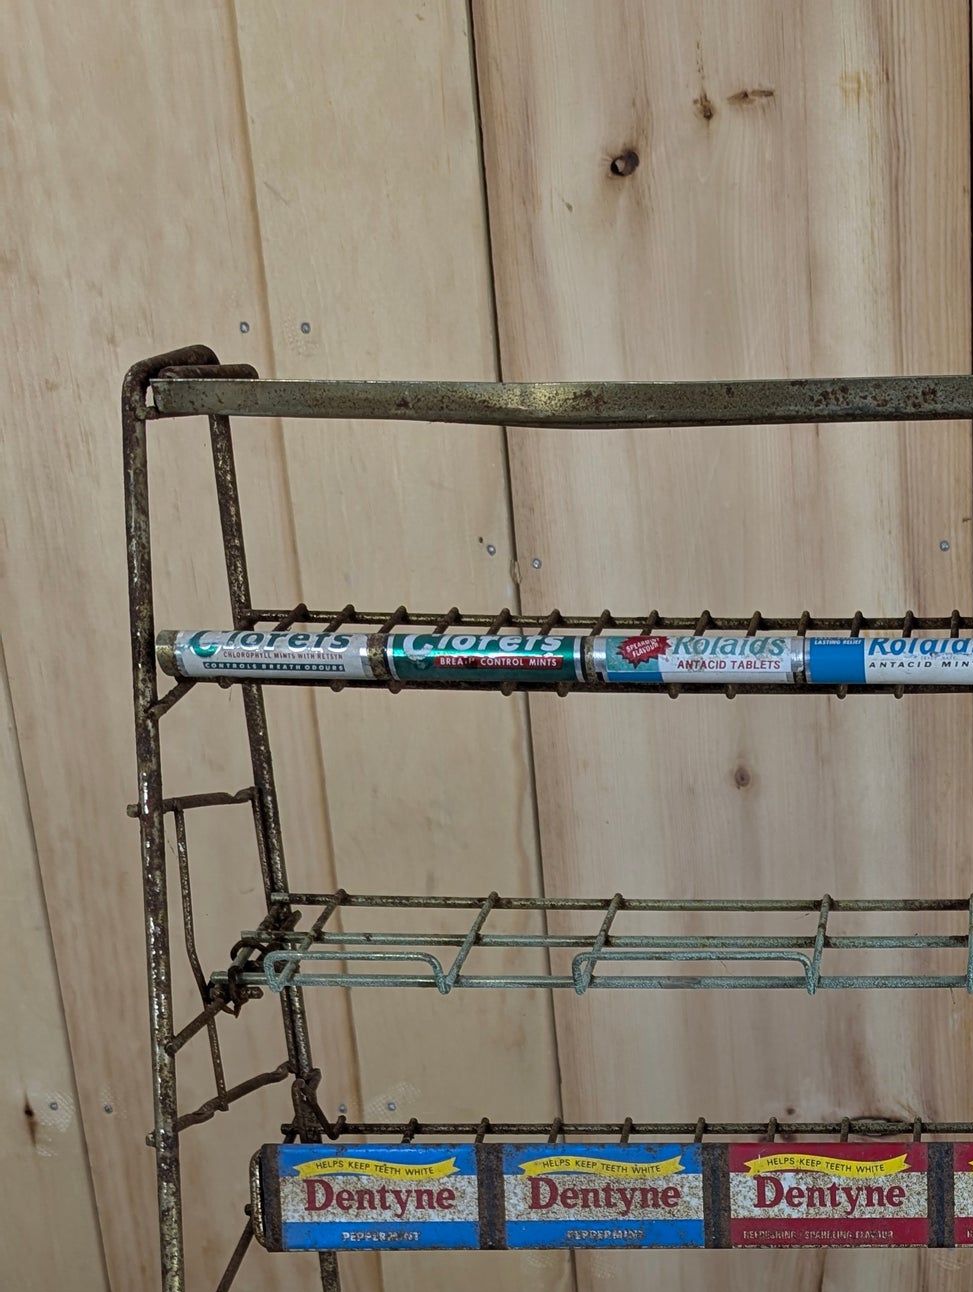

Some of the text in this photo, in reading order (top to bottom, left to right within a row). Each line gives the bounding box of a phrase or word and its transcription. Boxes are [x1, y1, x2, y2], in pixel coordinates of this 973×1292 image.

[189, 631, 352, 657] Clorets
[403, 634, 564, 661] Clorets
[632, 643, 659, 659] FLAVOUR
[672, 637, 786, 656] Rolaids
[224, 651, 271, 659] CHLOROPHYLL
[274, 652, 295, 660] MINTS
[440, 657, 557, 667] BREA CONTROL MINTS
[205, 662, 344, 672] CONTROLS BREATH ODOURS
[677, 660, 781, 669] ANTACID TABLETS
[869, 661, 933, 669] ANTACID
[316, 1160, 435, 1176] HELPS KEEP TEETH WHITE
[543, 1159, 661, 1174] HELPS KEEP TEETH WHITE
[767, 1157, 885, 1173] HELPS KEEP TEETH WHITE
[303, 1179, 456, 1218] Dentyne
[528, 1177, 681, 1217] Dentyne
[753, 1175, 905, 1215] Dentyne
[342, 1232, 420, 1242] PEPPERMNT
